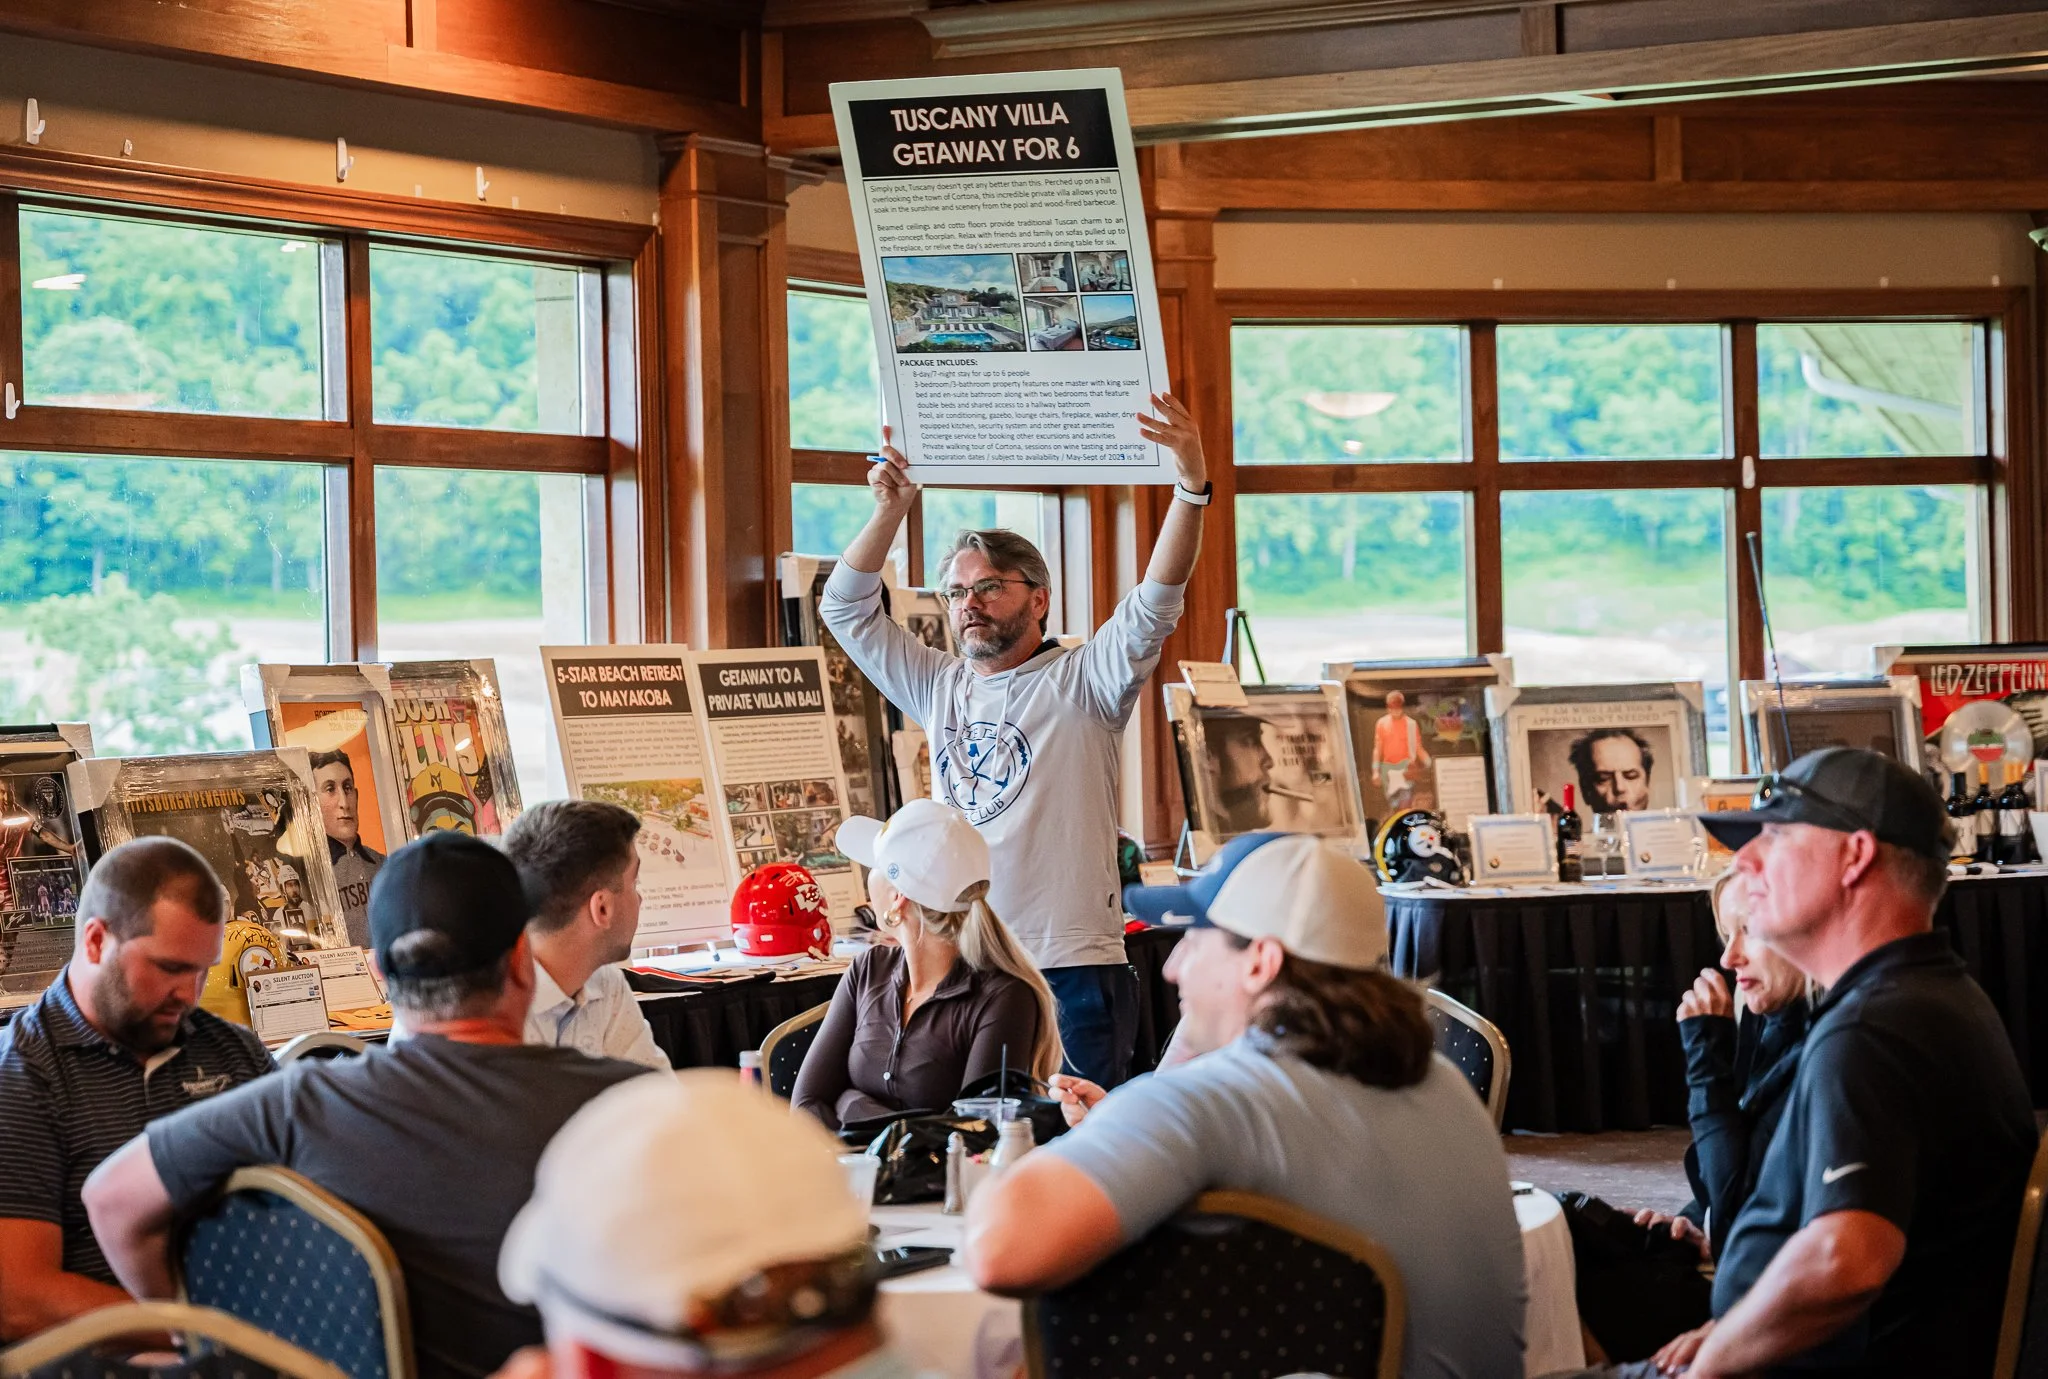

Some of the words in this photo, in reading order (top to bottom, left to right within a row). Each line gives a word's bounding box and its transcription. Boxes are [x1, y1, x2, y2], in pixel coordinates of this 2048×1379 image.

[890, 105, 998, 132] TUSCANY
[1004, 102, 1070, 126] VILLA
[892, 139, 1006, 166] GETAWAY
[1012, 137, 1062, 160] FOR
[1066, 136, 1080, 159] 6
[870, 185, 893, 194] Simply
[908, 183, 936, 192] Tuscany
[936, 182, 962, 190] doesn't
[962, 182, 975, 190] get
[988, 180, 1010, 188] better
[1044, 178, 1073, 186] Perched
[872, 195, 912, 205] overlooking
[996, 191, 1030, 199] incredible
[1030, 190, 1056, 199] private
[1056, 189, 1071, 197] villa
[1071, 188, 1094, 196] allows
[1095, 189, 1109, 197] you
[910, 204, 940, 212] sunshine
[955, 204, 982, 212] scenery
[982, 202, 1000, 210] from
[1012, 201, 1029, 210] pool
[1044, 199, 1083, 208] wood-fired
[906, 223, 931, 232] ceilings
[989, 220, 1015, 229] provide
[1017, 219, 1053, 227] traditional
[1055, 218, 1079, 226] Tuscan
[1080, 217, 1103, 225] charm
[878, 234, 924, 243] open-concept
[1032, 230, 1054, 239] family
[1084, 228, 1107, 237] pulled
[933, 243, 952, 251] relive
[965, 243, 983, 251] day's
[984, 241, 1021, 249] adventures
[1053, 240, 1075, 249] dining
[1075, 239, 1093, 247] table
[957, 370, 971, 378] stay
[992, 369, 1001, 377] to
[1006, 369, 1031, 378] people
[992, 380, 1021, 389] property
[1106, 379, 1122, 388] king
[920, 433, 953, 441] Concierge
[988, 433, 1015, 441] booking
[945, 443, 971, 451] walking
[1080, 443, 1104, 451] tasting
[557, 666, 598, 684] 5-STAR
[598, 665, 640, 682] BEACH
[640, 665, 684, 681] RETREAT
[719, 668, 774, 686] GETAWAY
[775, 667, 792, 684] TO
[794, 667, 804, 683] A
[579, 690, 598, 708] TO
[600, 689, 672, 707] MAYAKOBA
[708, 693, 753, 711] PRIVATE
[753, 692, 784, 709] VILLA
[784, 691, 798, 708] IN
[798, 690, 822, 706] BALI
[399, 722, 478, 778] LLIS
[125, 791, 192, 813] ITTSBURGH
[193, 788, 246, 808] PENGUINS
[970, 798, 1004, 822] CLUB
[320, 952, 336, 960] SILENT
[336, 950, 358, 958] AUCTION
[272, 975, 290, 984] SILENT
[292, 972, 314, 981] AUCTION
